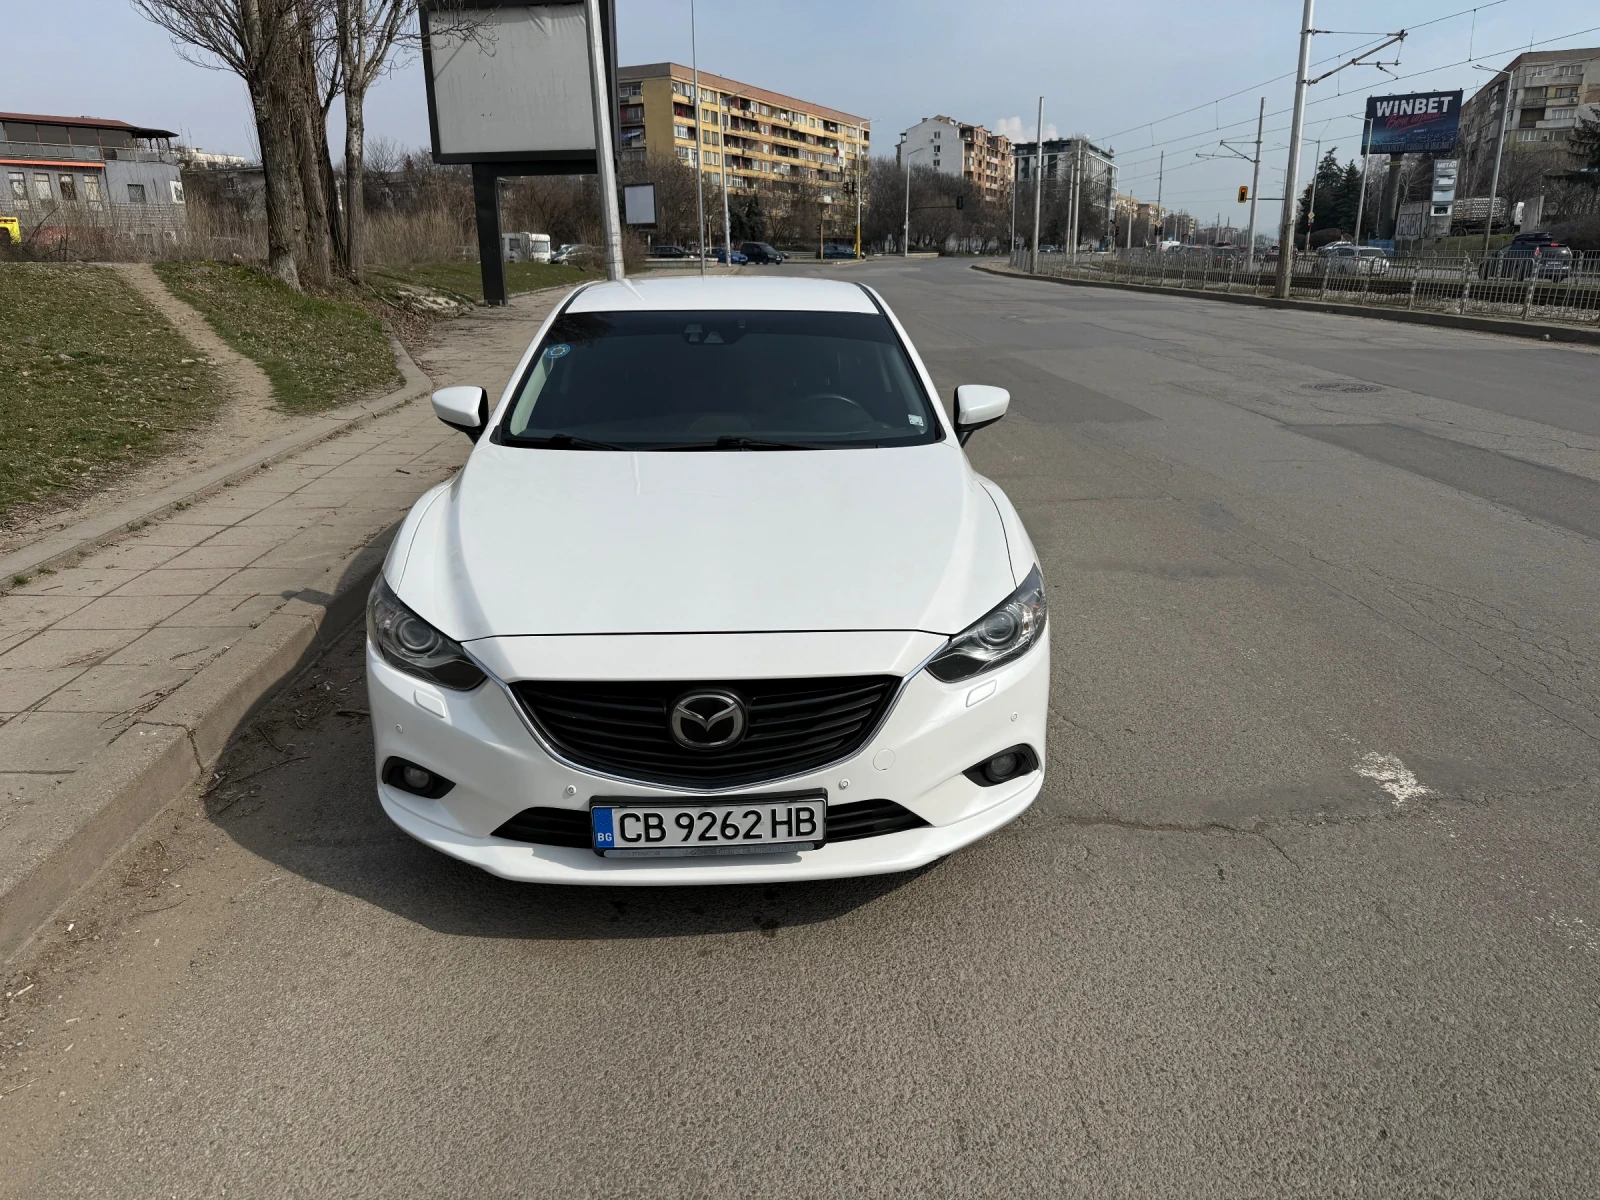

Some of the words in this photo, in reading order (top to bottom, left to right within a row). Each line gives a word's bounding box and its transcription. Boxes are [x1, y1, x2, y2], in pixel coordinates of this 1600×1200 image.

[1376, 96, 1453, 117] WINBET
[619, 812, 667, 843] CB
[674, 809, 763, 842] 9262
[770, 806, 818, 839] HB
[597, 833, 613, 842] BG
